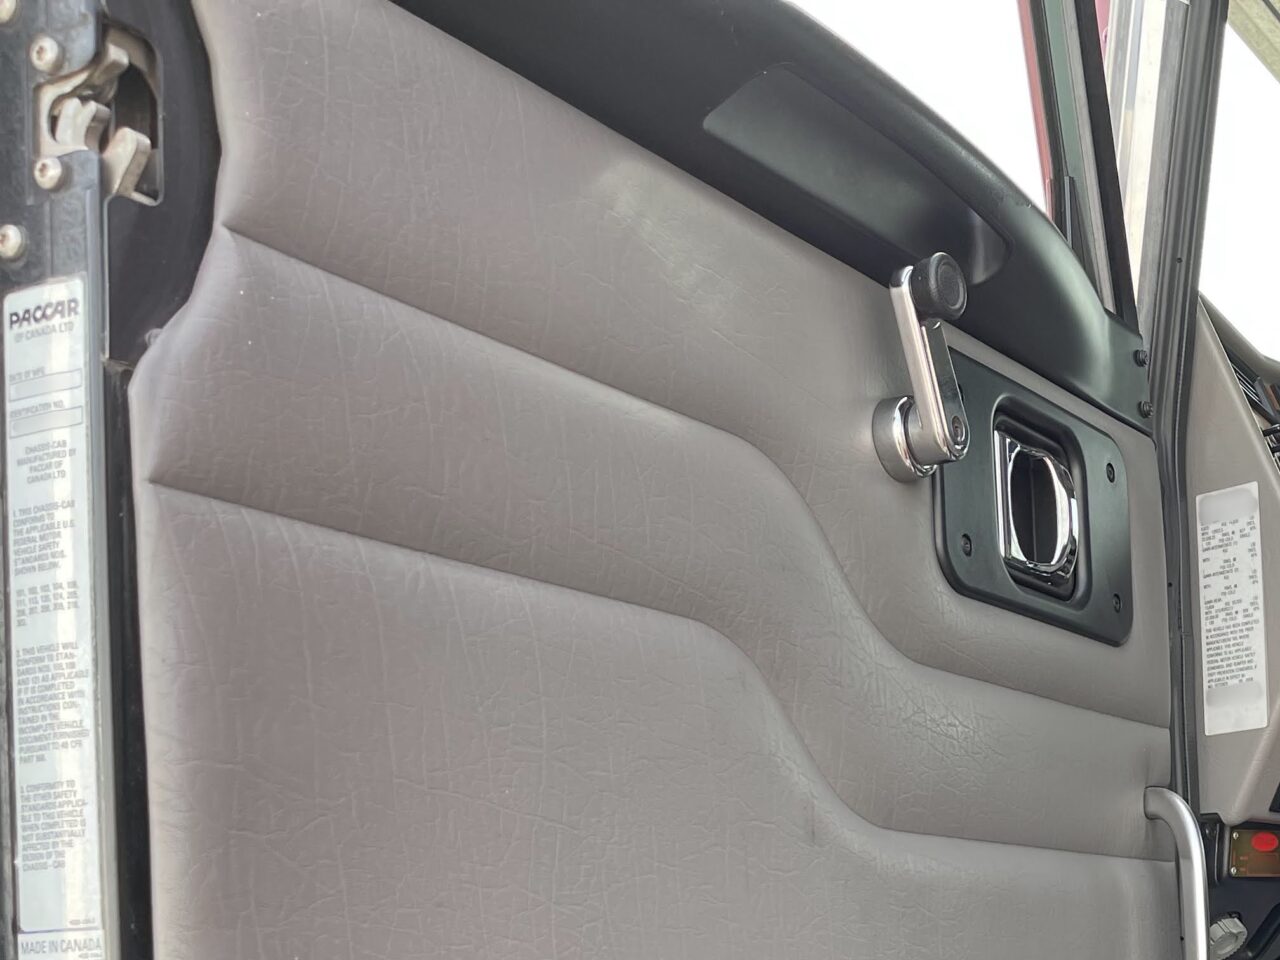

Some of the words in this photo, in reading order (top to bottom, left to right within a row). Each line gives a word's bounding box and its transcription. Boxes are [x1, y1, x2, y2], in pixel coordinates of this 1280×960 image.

[9, 298, 79, 331] PACCAR
[25, 324, 57, 340] CANADA
[59, 321, 74, 333] LTD
[25, 521, 60, 535] APPLICABLE
[38, 541, 59, 552] SAFETY
[21, 940, 47, 954] MADE
[47, 939, 59, 953] IN
[60, 937, 101, 953] CANADA
